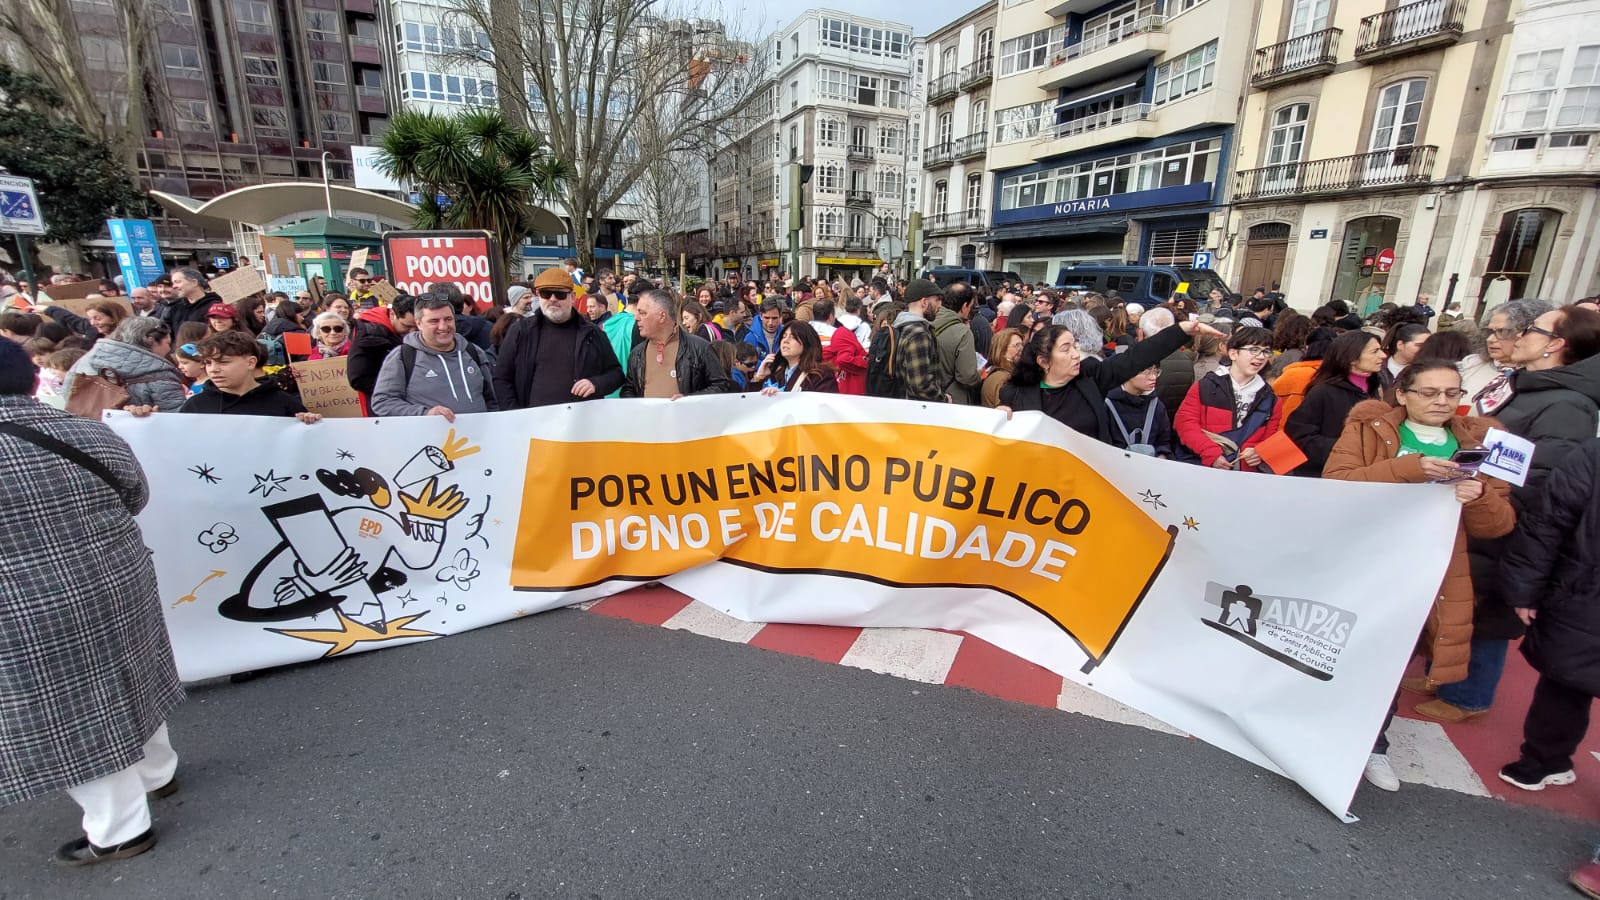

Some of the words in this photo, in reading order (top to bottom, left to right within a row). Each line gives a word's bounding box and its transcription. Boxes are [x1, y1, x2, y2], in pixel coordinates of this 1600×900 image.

[1054, 198, 1110, 215] NOTARIA
[1196, 254, 1207, 267] P
[296, 368, 348, 384] ENSIN
[570, 473, 653, 511] POR
[660, 467, 719, 506] UN
[725, 453, 870, 500] ENSINO
[883, 450, 1091, 536] PÚBLICO
[360, 517, 383, 535] EPD
[571, 512, 710, 560] DIGNO
[718, 508, 748, 546] E
[753, 501, 797, 543] DE
[810, 501, 1078, 582] CALIDADE
[1267, 630, 1279, 639] de
[1303, 635, 1341, 655] Provincial
[1300, 653, 1334, 672] Coruña
